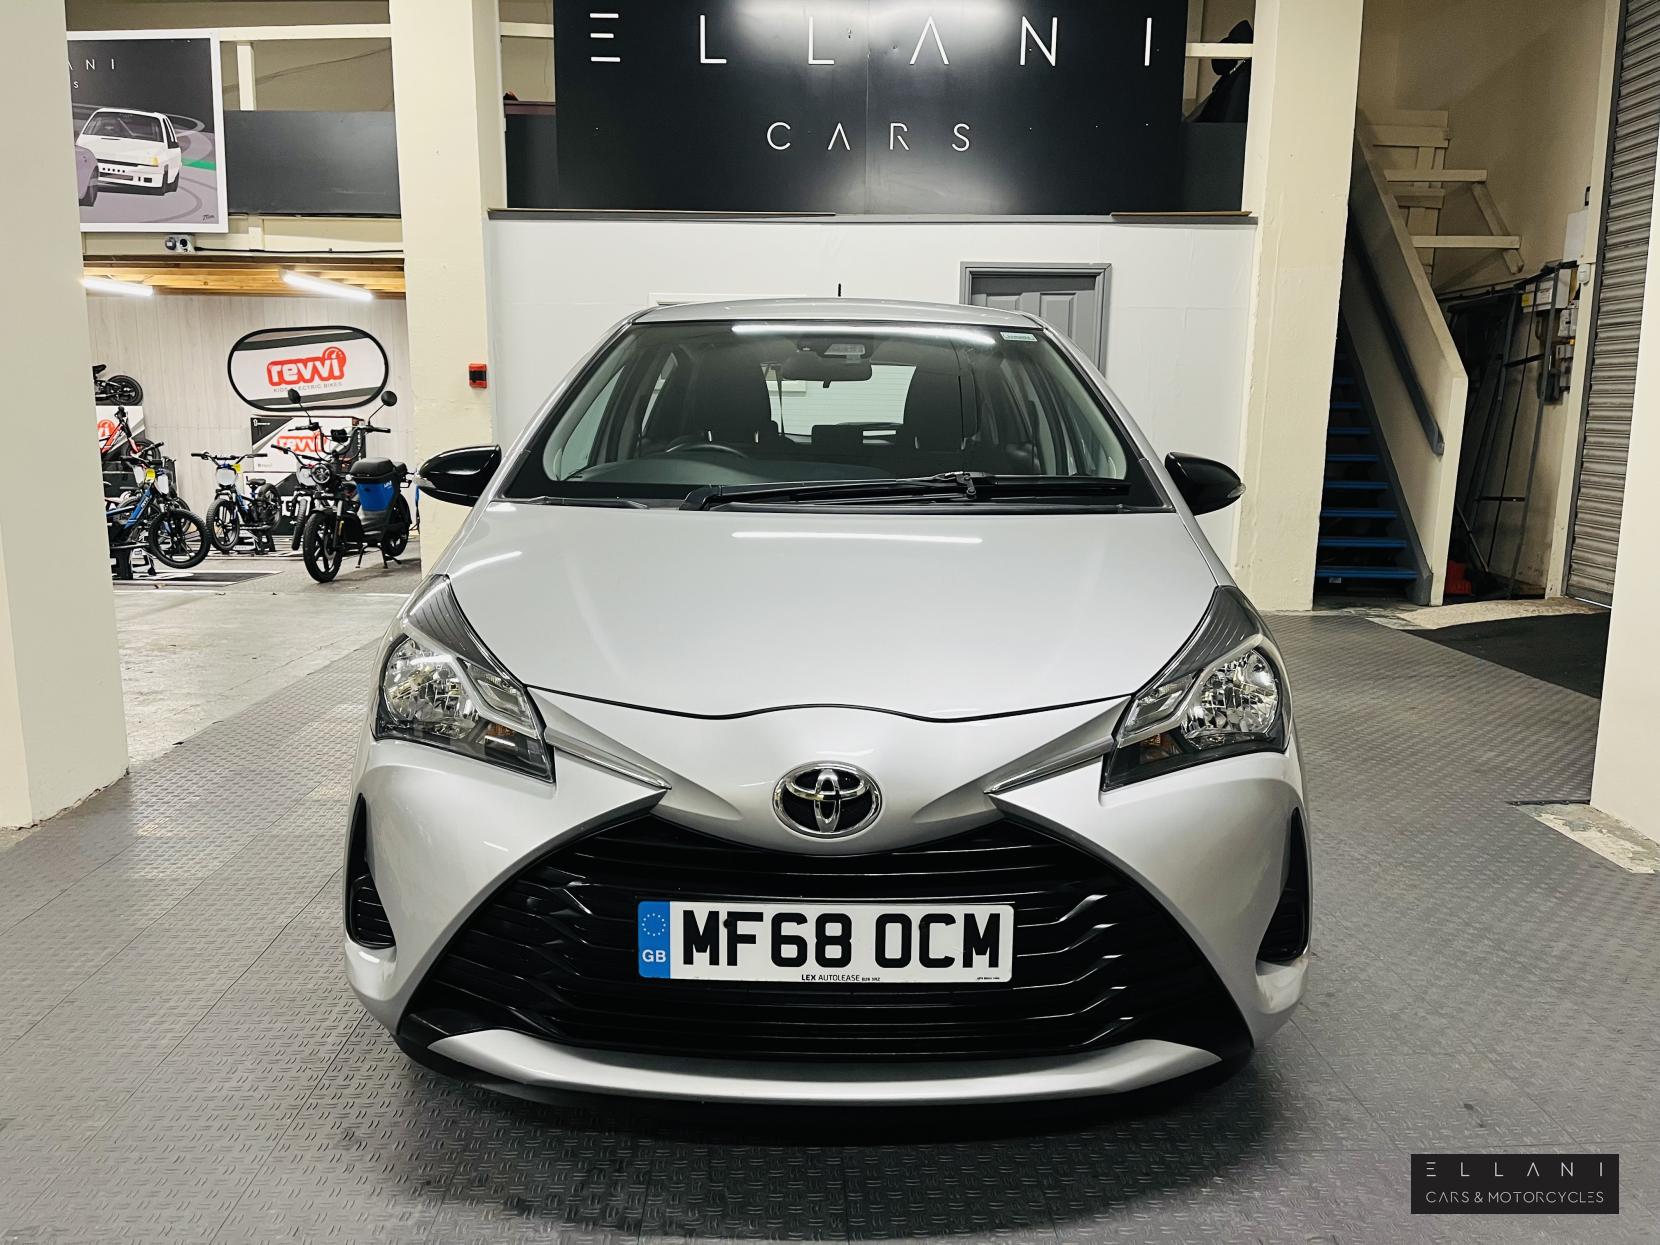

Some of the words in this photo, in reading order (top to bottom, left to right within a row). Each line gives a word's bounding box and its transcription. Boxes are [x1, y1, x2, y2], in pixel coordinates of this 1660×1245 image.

[589, 12, 1152, 67] ELLANI
[766, 121, 971, 151] CARS
[269, 350, 342, 384] revvi
[290, 384, 322, 392] ECTRIC
[682, 909, 853, 968] MF68
[874, 912, 1001, 969] OCM
[641, 949, 667, 963] GB
[818, 974, 860, 982] AUTOLEASE
